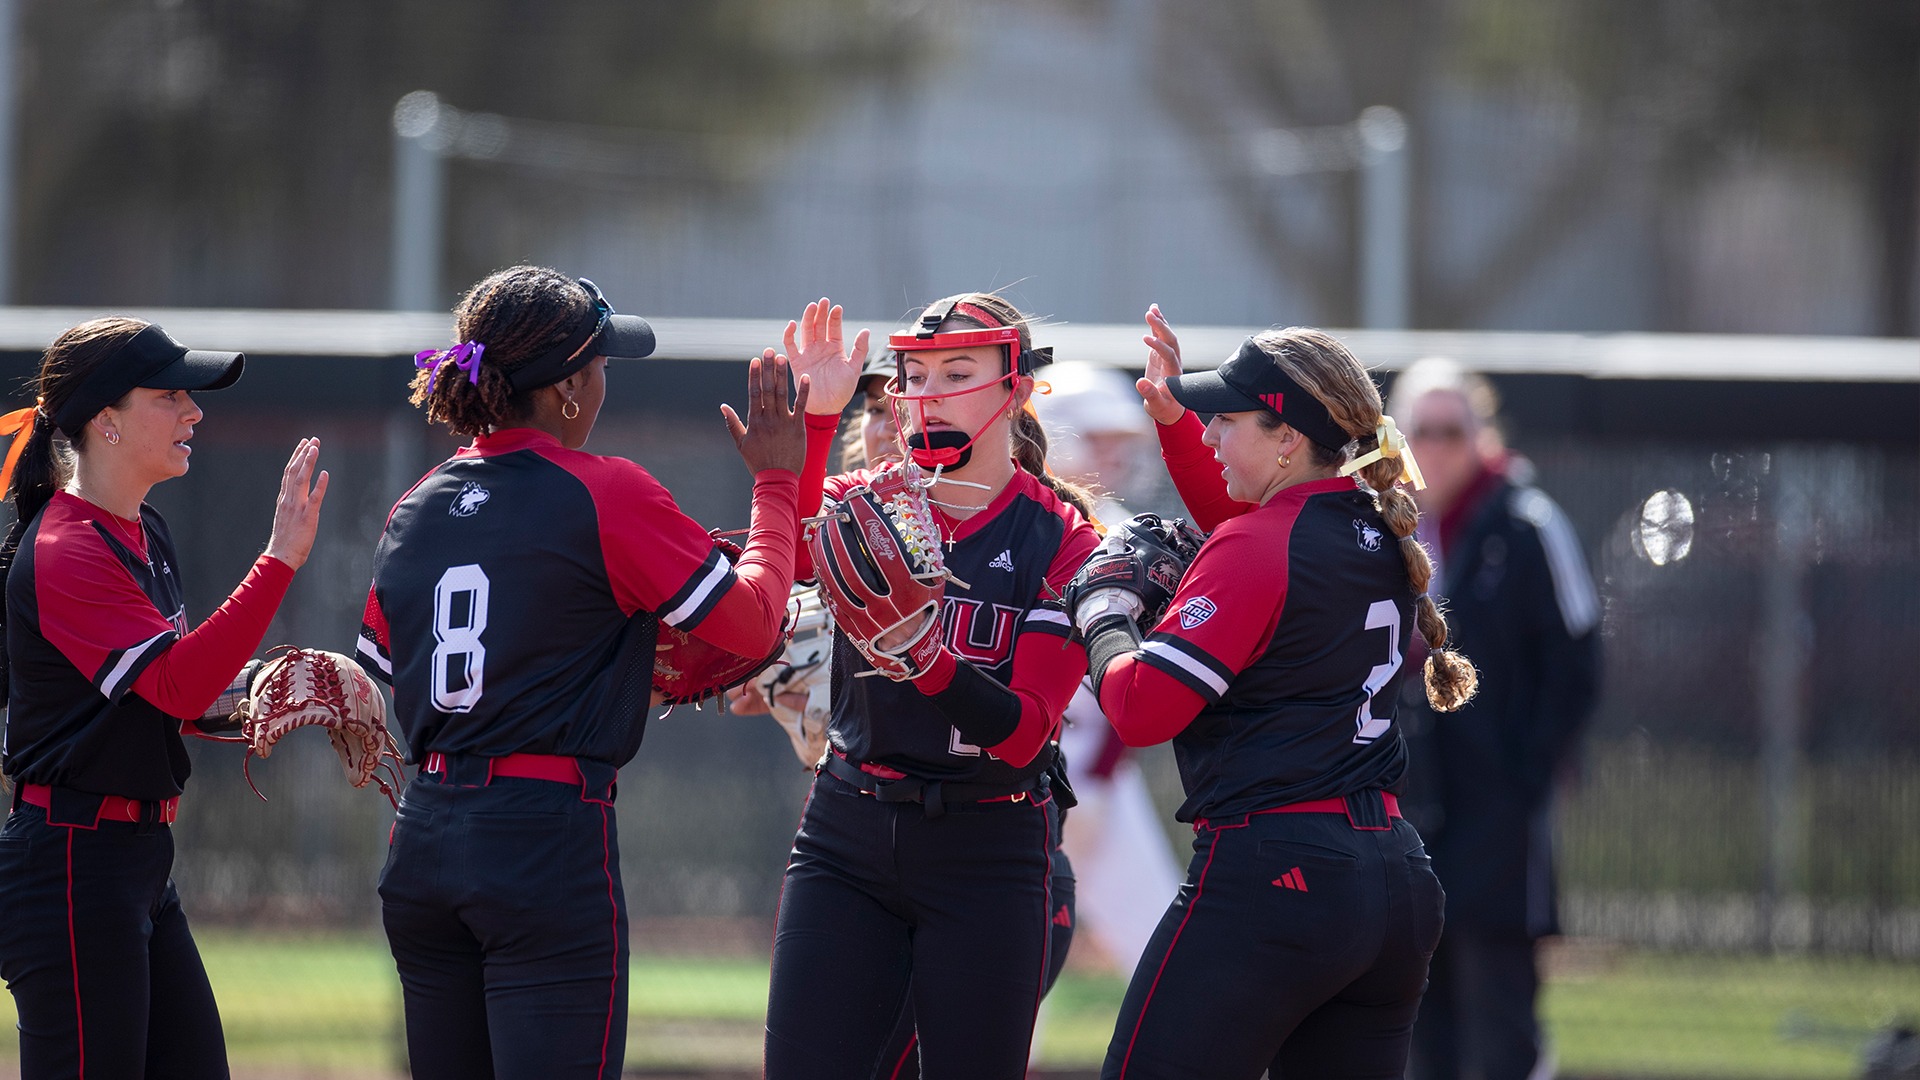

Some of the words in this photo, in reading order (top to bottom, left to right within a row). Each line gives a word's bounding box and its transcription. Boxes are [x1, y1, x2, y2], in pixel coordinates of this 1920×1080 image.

[865, 519, 895, 560] Rawlings
[989, 561, 1014, 572] adidas
[1148, 567, 1178, 592] NIU
[431, 564, 490, 713] 8
[942, 595, 1024, 671] U
[1353, 599, 1403, 744] 2
